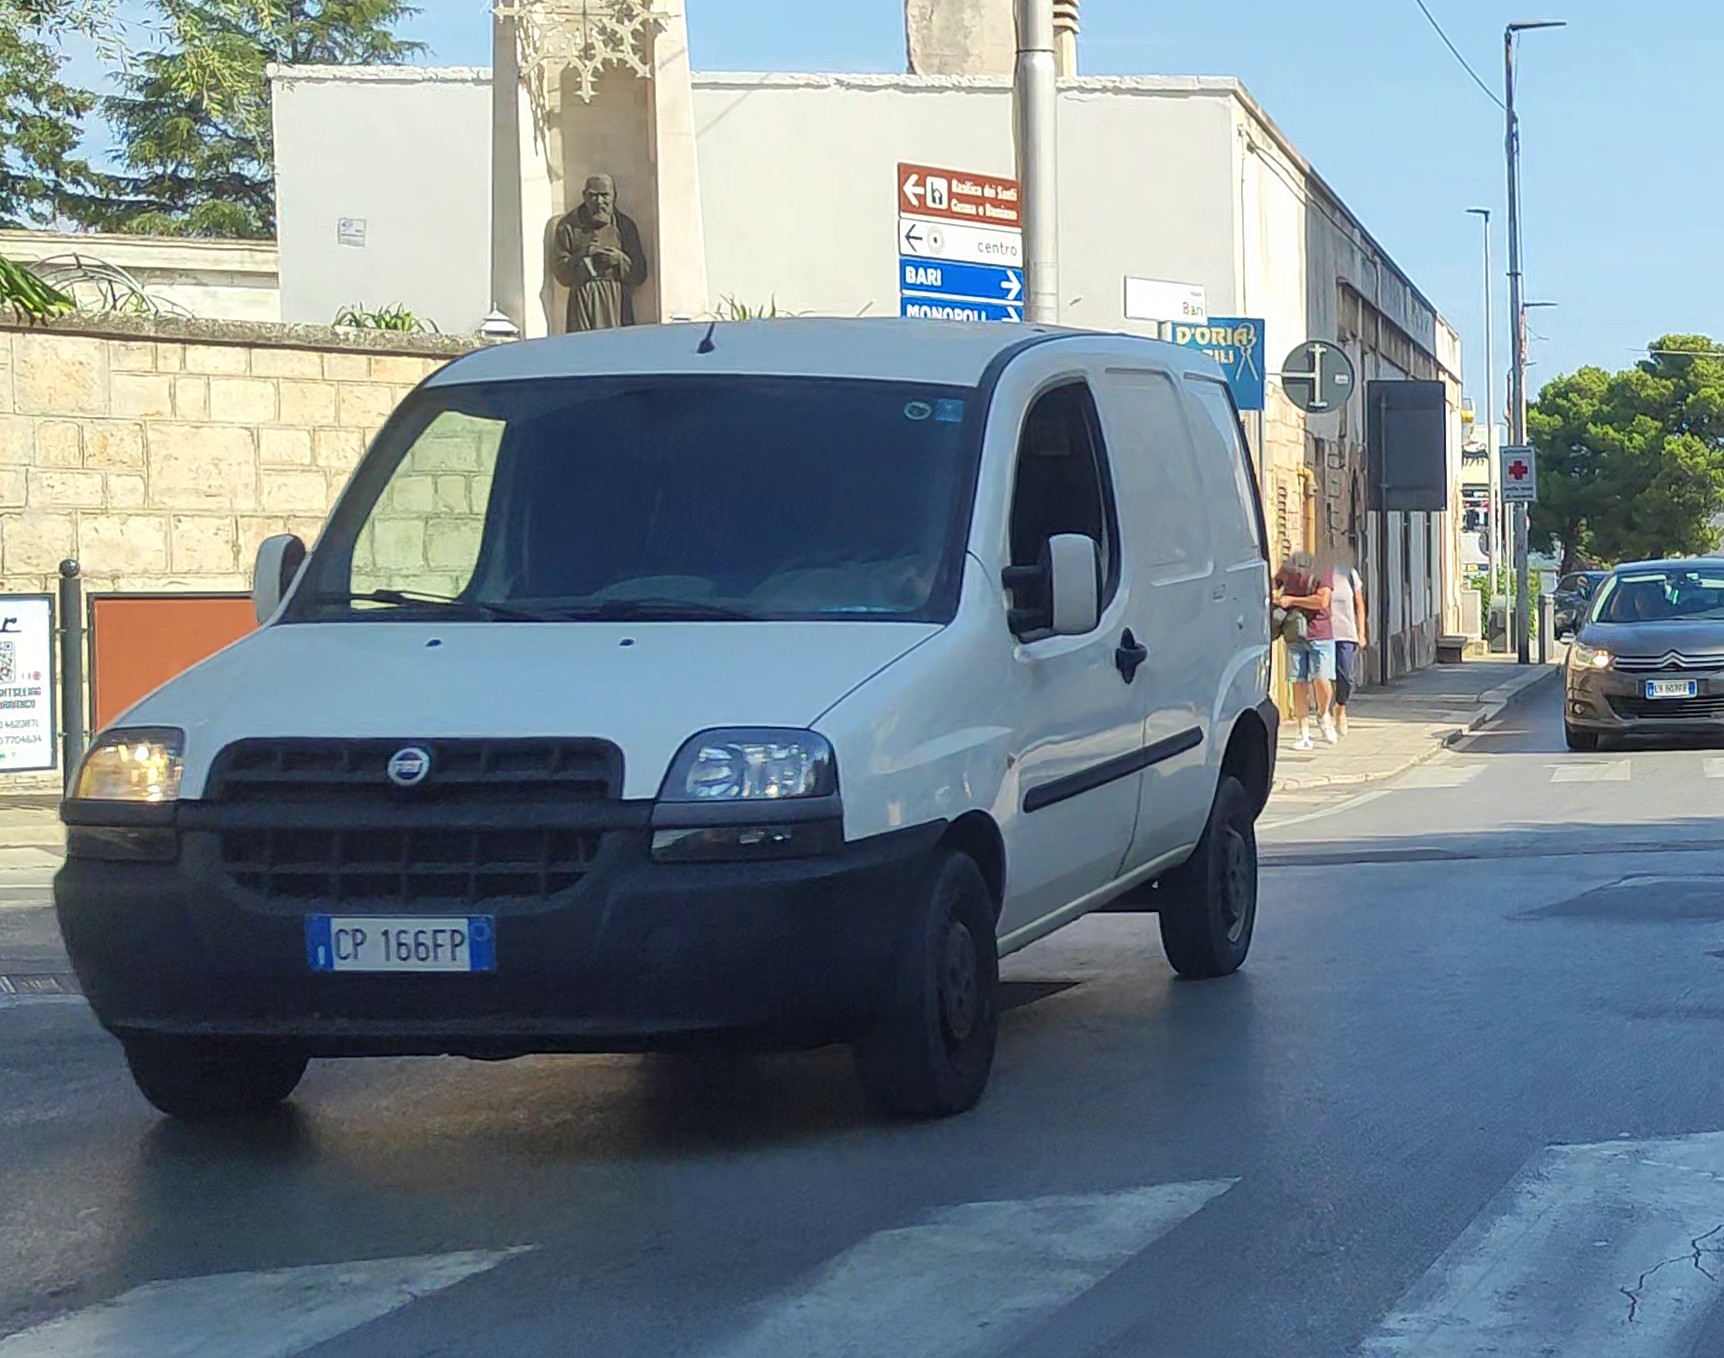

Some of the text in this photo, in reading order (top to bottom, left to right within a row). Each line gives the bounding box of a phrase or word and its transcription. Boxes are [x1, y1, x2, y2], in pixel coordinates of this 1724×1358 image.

[977, 240, 1018, 257] centro
[905, 265, 942, 287] BARI
[335, 928, 367, 962] CP
[381, 928, 466, 962] 166FP
